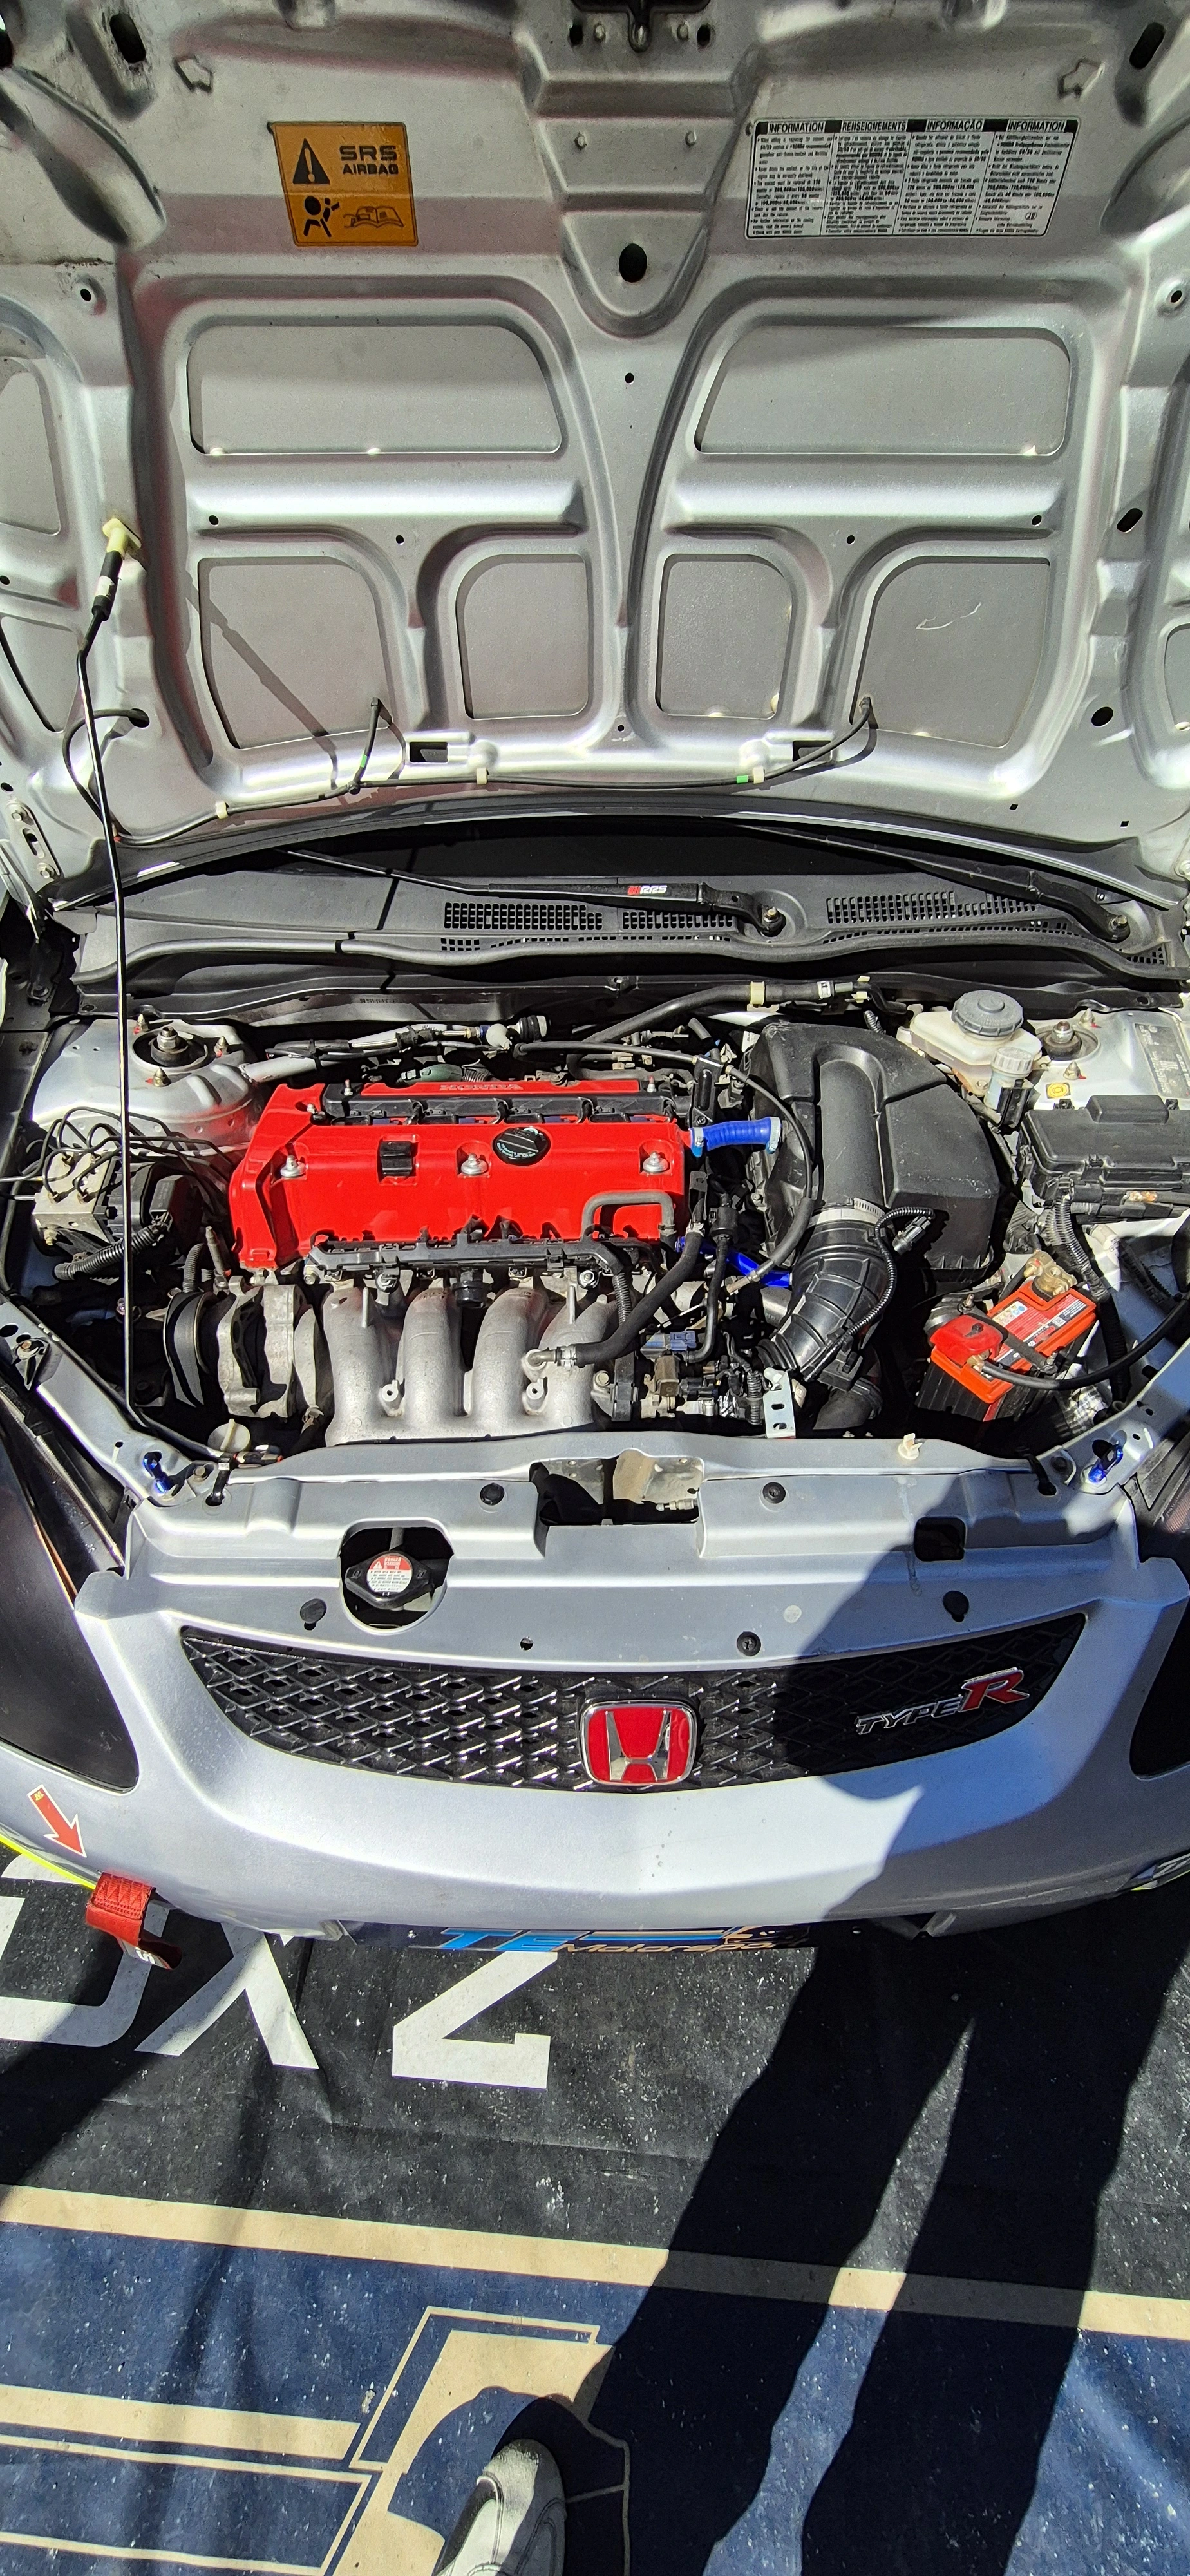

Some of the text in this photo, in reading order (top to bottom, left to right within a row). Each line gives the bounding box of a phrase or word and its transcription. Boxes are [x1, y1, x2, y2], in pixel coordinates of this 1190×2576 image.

[769, 122, 824, 133] INFORMATION
[842, 121, 907, 131] RENSEIGNEMENTS
[927, 119, 983, 131] INFORMAÇÃO
[1008, 121, 1066, 131] INFORMATION
[339, 144, 398, 162] SRS
[342, 163, 399, 175] AIRBAG
[855, 1666, 1030, 1735] TYPE R
